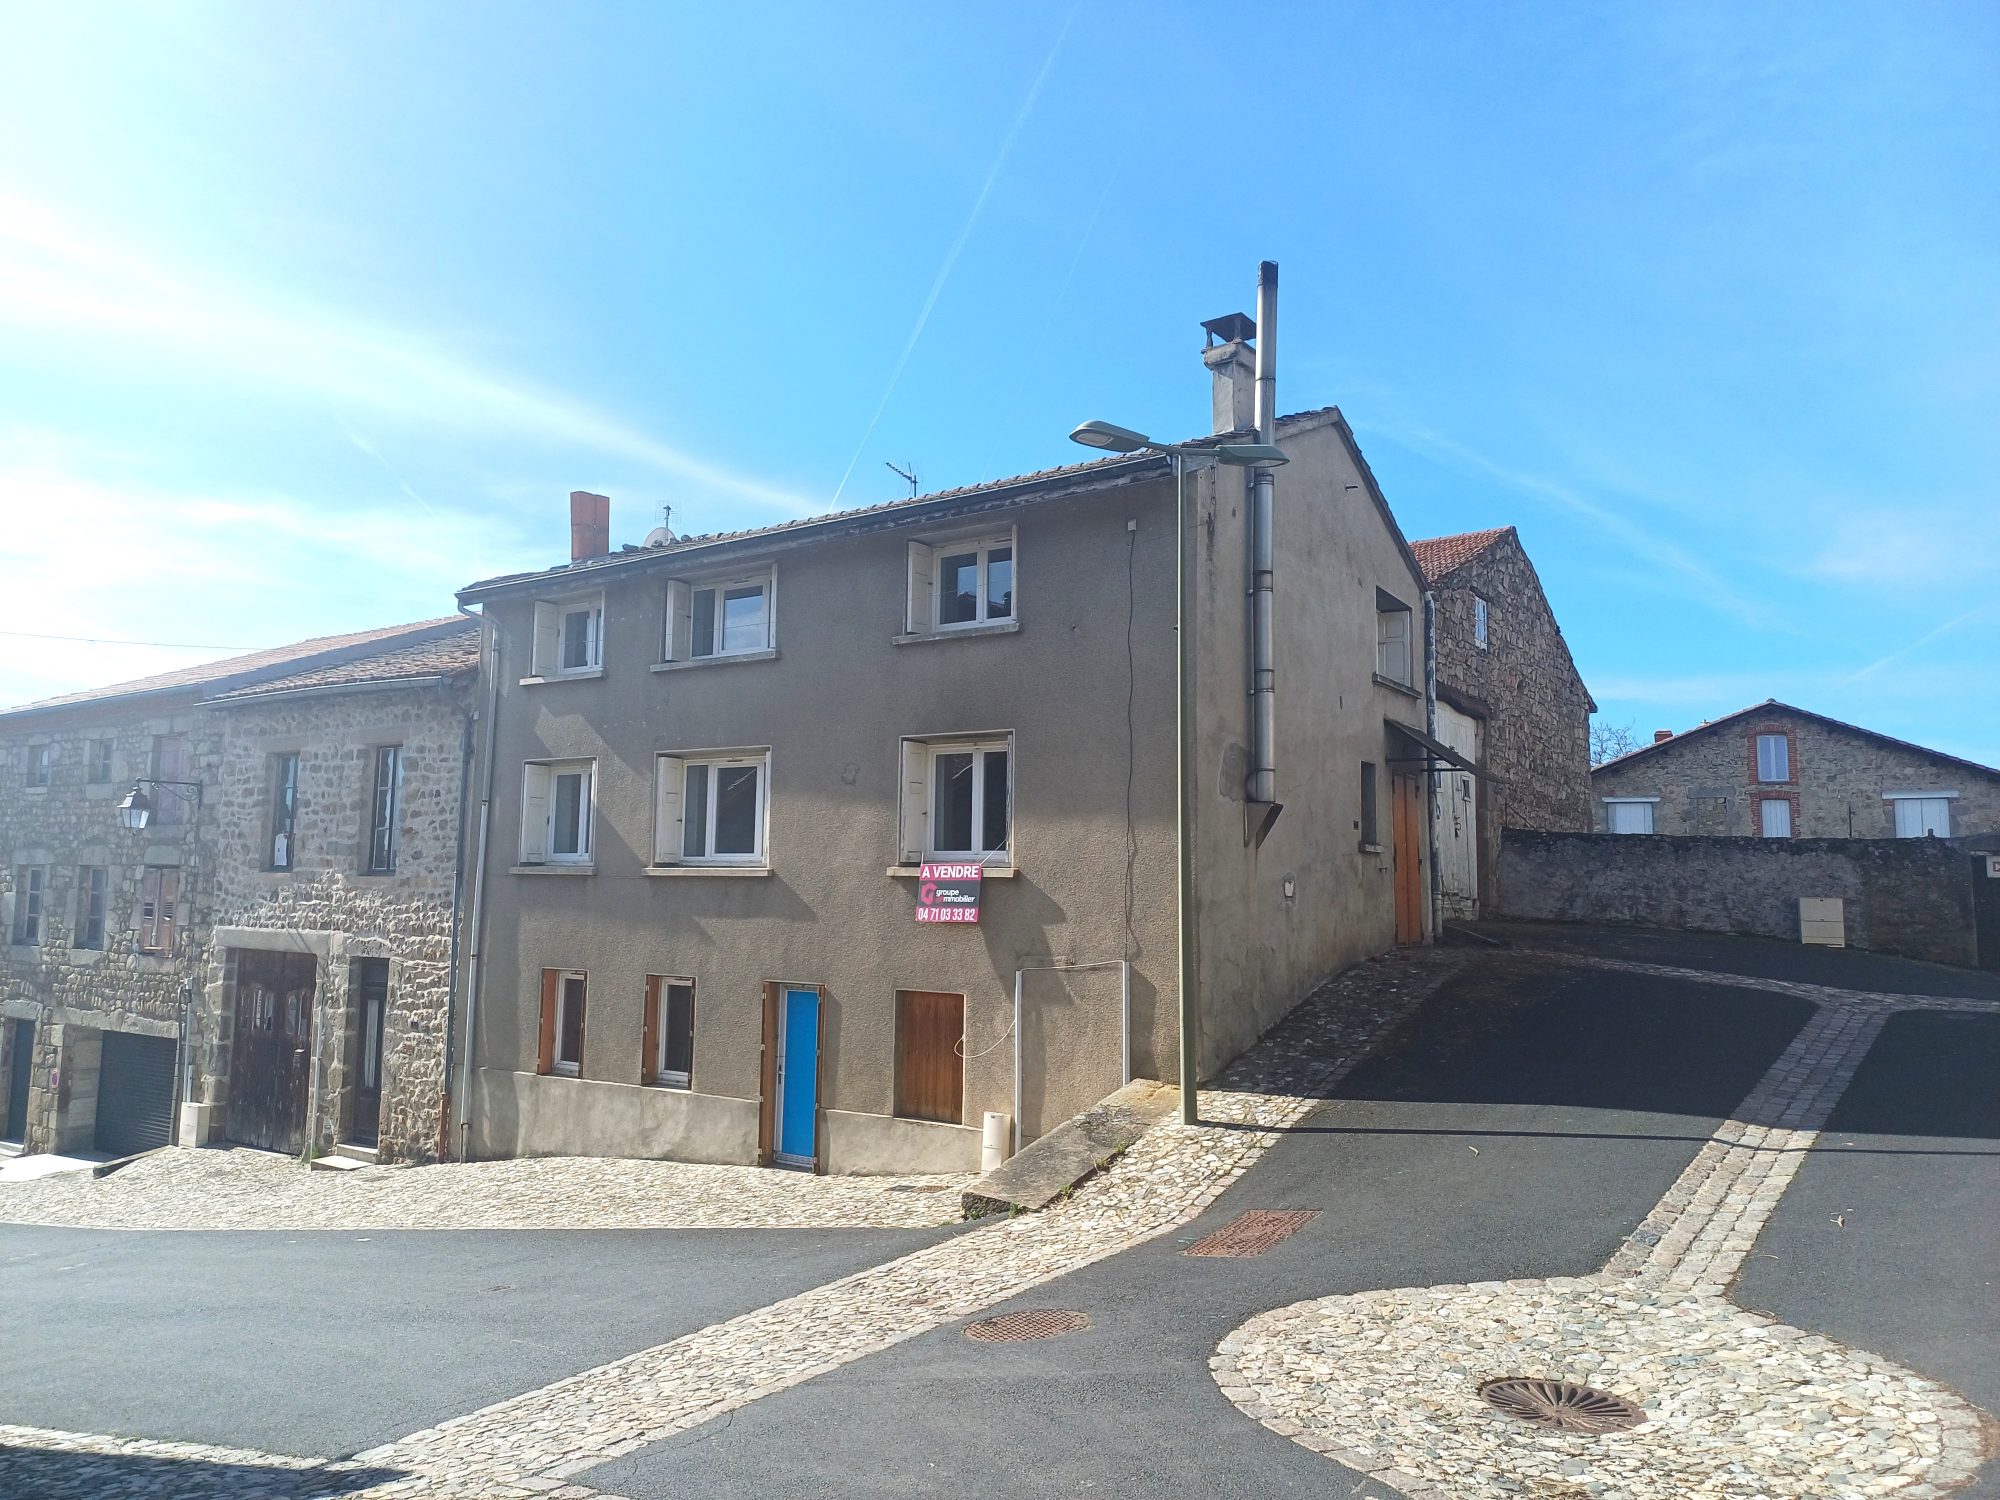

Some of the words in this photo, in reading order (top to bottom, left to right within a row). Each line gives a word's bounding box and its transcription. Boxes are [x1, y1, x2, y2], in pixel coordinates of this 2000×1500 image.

[921, 866, 930, 878] A
[933, 865, 979, 878] VENDRE
[936, 889, 959, 897] groupe
[918, 908, 928, 920] 04
[930, 908, 939, 920] 71
[940, 908, 951, 920] 03
[952, 908, 963, 920] 33
[964, 908, 975, 920] 82
